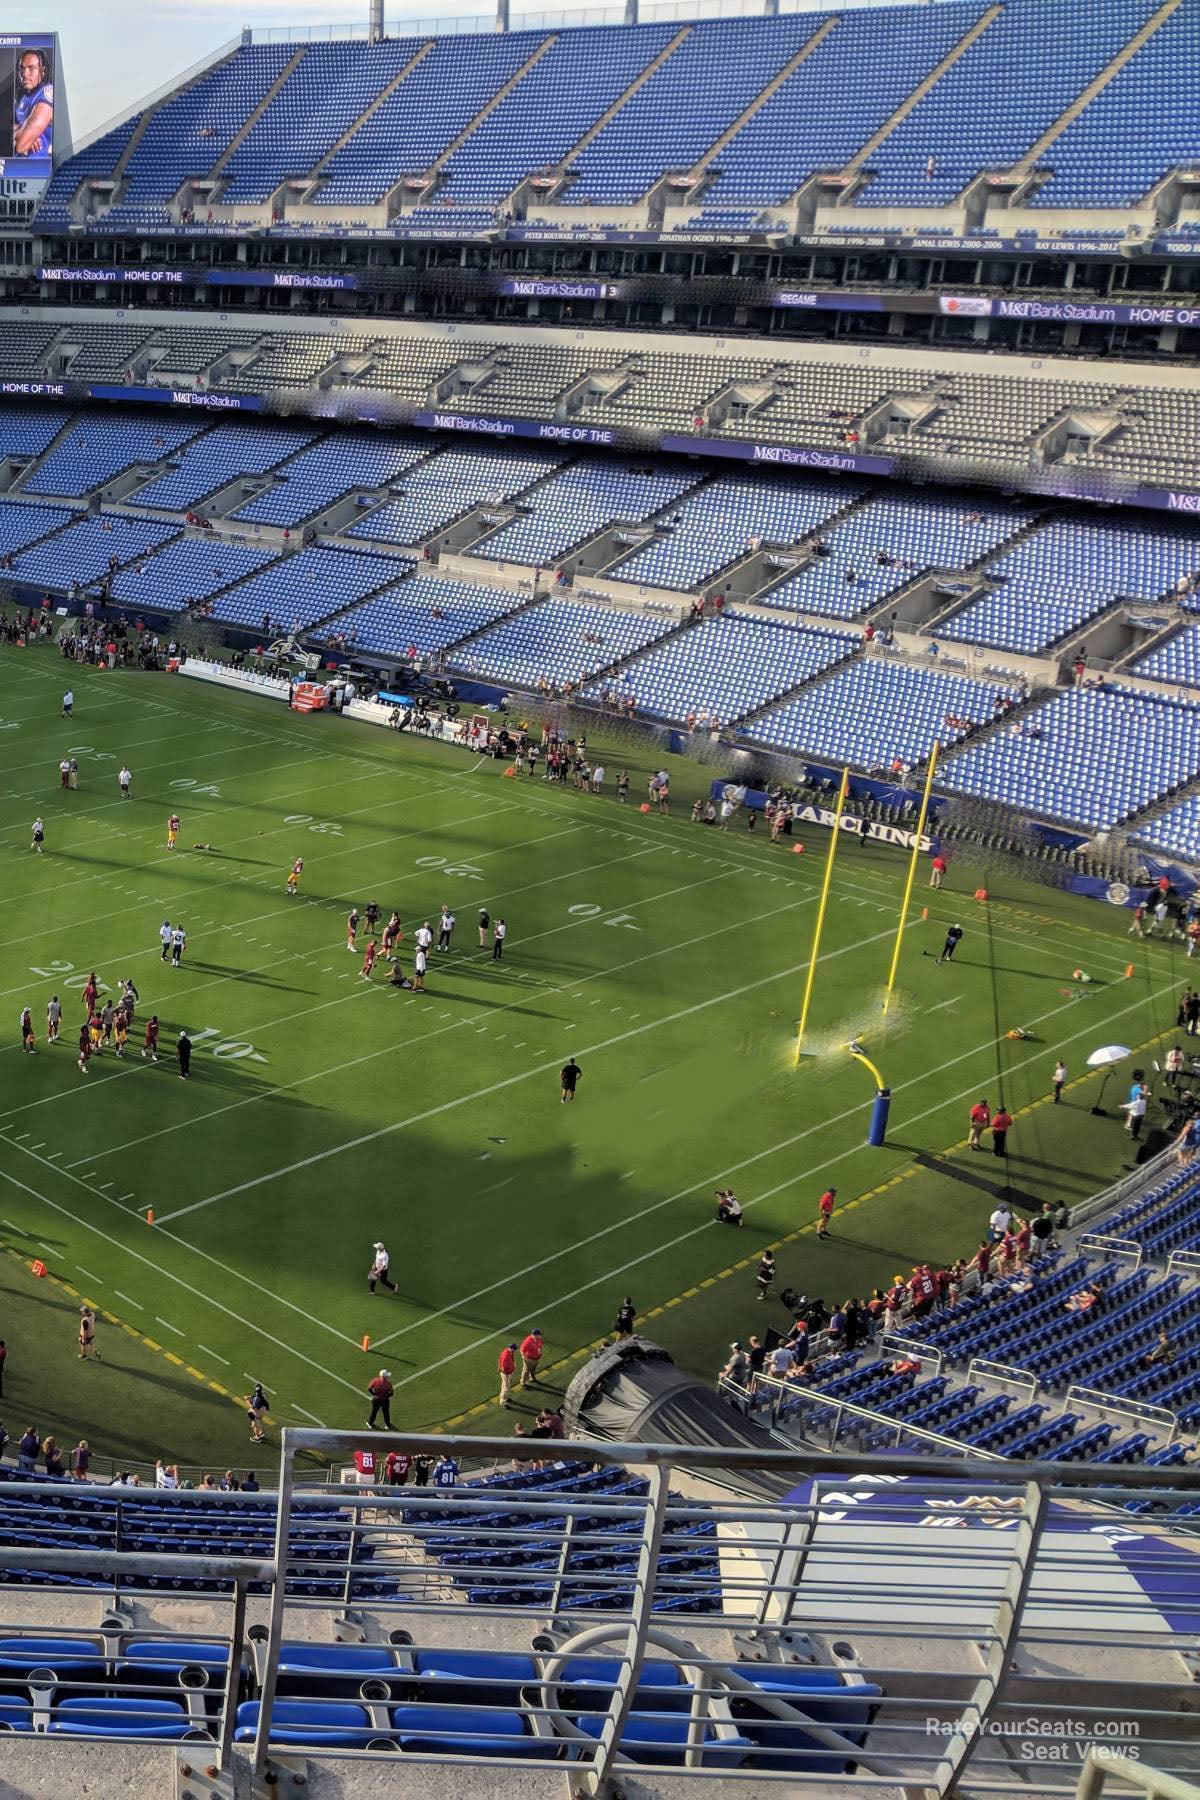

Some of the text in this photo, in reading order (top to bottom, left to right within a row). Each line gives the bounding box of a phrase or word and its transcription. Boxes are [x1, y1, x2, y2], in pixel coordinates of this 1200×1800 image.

[0, 37, 22, 45] CAREER
[0, 179, 27, 198] Lite
[408, 230, 432, 238] MICHAEL
[524, 232, 542, 240] PETER
[658, 234, 750, 244] JONATHAN OGDEN 1996-2007
[912, 238, 1003, 249] JAMAL LEWIS 2000-2006
[1035, 241, 1120, 251] RAY LEWIS 1996-2012
[1167, 243, 1192, 252] TODD
[42, 268, 182, 281] M&T Bank Stadium HOME OF THE
[274, 274, 344, 288] M&T Bank Stadium
[513, 281, 537, 295] M&T
[537, 283, 559, 296] Bank
[560, 284, 596, 296] Stadium
[1000, 301, 1031, 316] M&T
[1032, 302, 1062, 318] Bank
[1063, 304, 1116, 320] Stadium
[1129, 308, 1174, 322] HOME
[1177, 310, 1200, 323] OF
[2, 383, 29, 393] HOME
[31, 384, 43, 394] OF
[44, 385, 64, 395] THE
[173, 392, 240, 408] M&T Bank Stadium
[434, 414, 611, 442] M&T Bank Stadium HOME OF THE
[753, 445, 856, 470] M&T Bank Stadium
[169, 778, 222, 799] 40
[284, 814, 344, 837] 30
[415, 855, 484, 881] 20
[568, 903, 640, 931] 10
[29, 959, 104, 990] 20
[191, 1027, 259, 1060] 10
[922, 1280, 934, 1294] 21
[362, 1457, 373, 1468] 81
[393, 1462, 408, 1474] 47
[441, 1472, 454, 1484] 81
